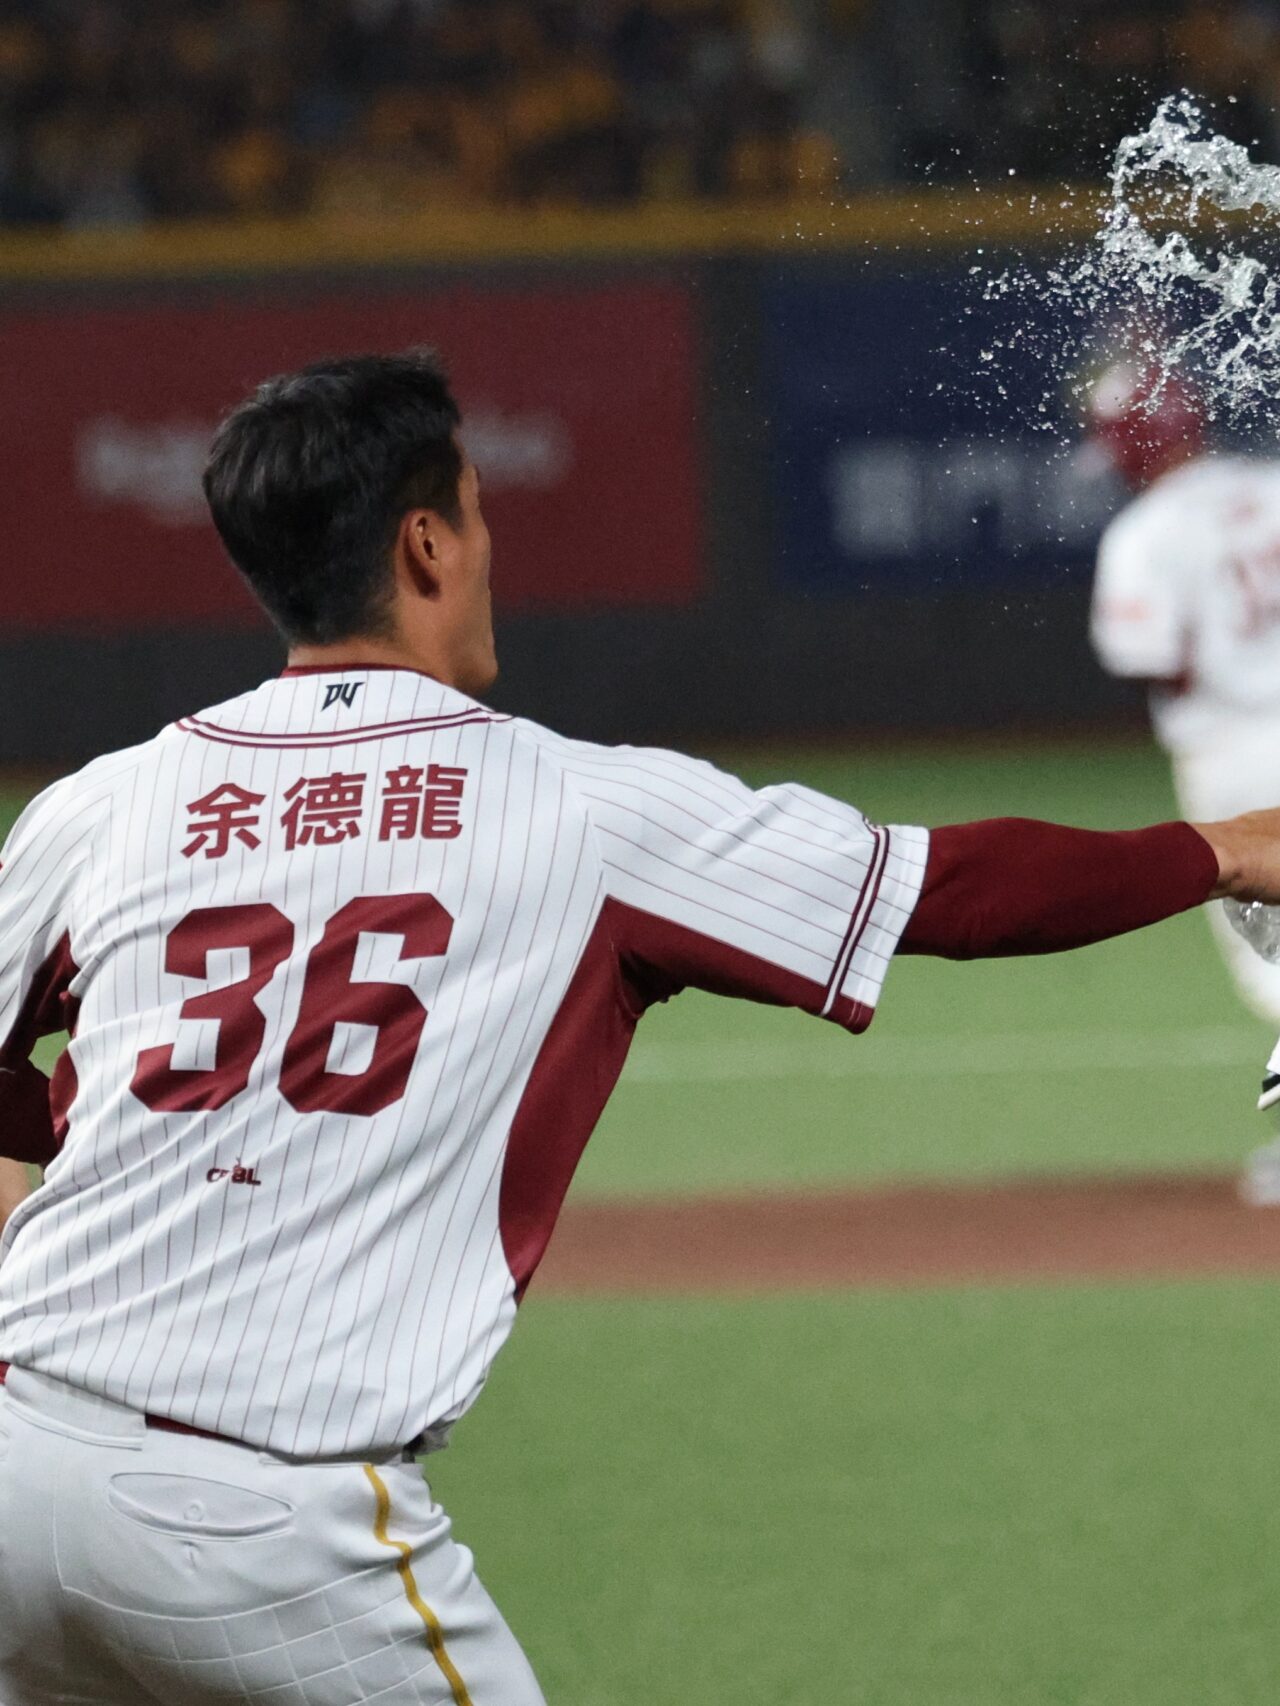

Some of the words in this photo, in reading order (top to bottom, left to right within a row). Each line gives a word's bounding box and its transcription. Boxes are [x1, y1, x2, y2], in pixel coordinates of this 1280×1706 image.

[179, 762, 469, 860] 余德龍
[128, 891, 455, 1117] 36
